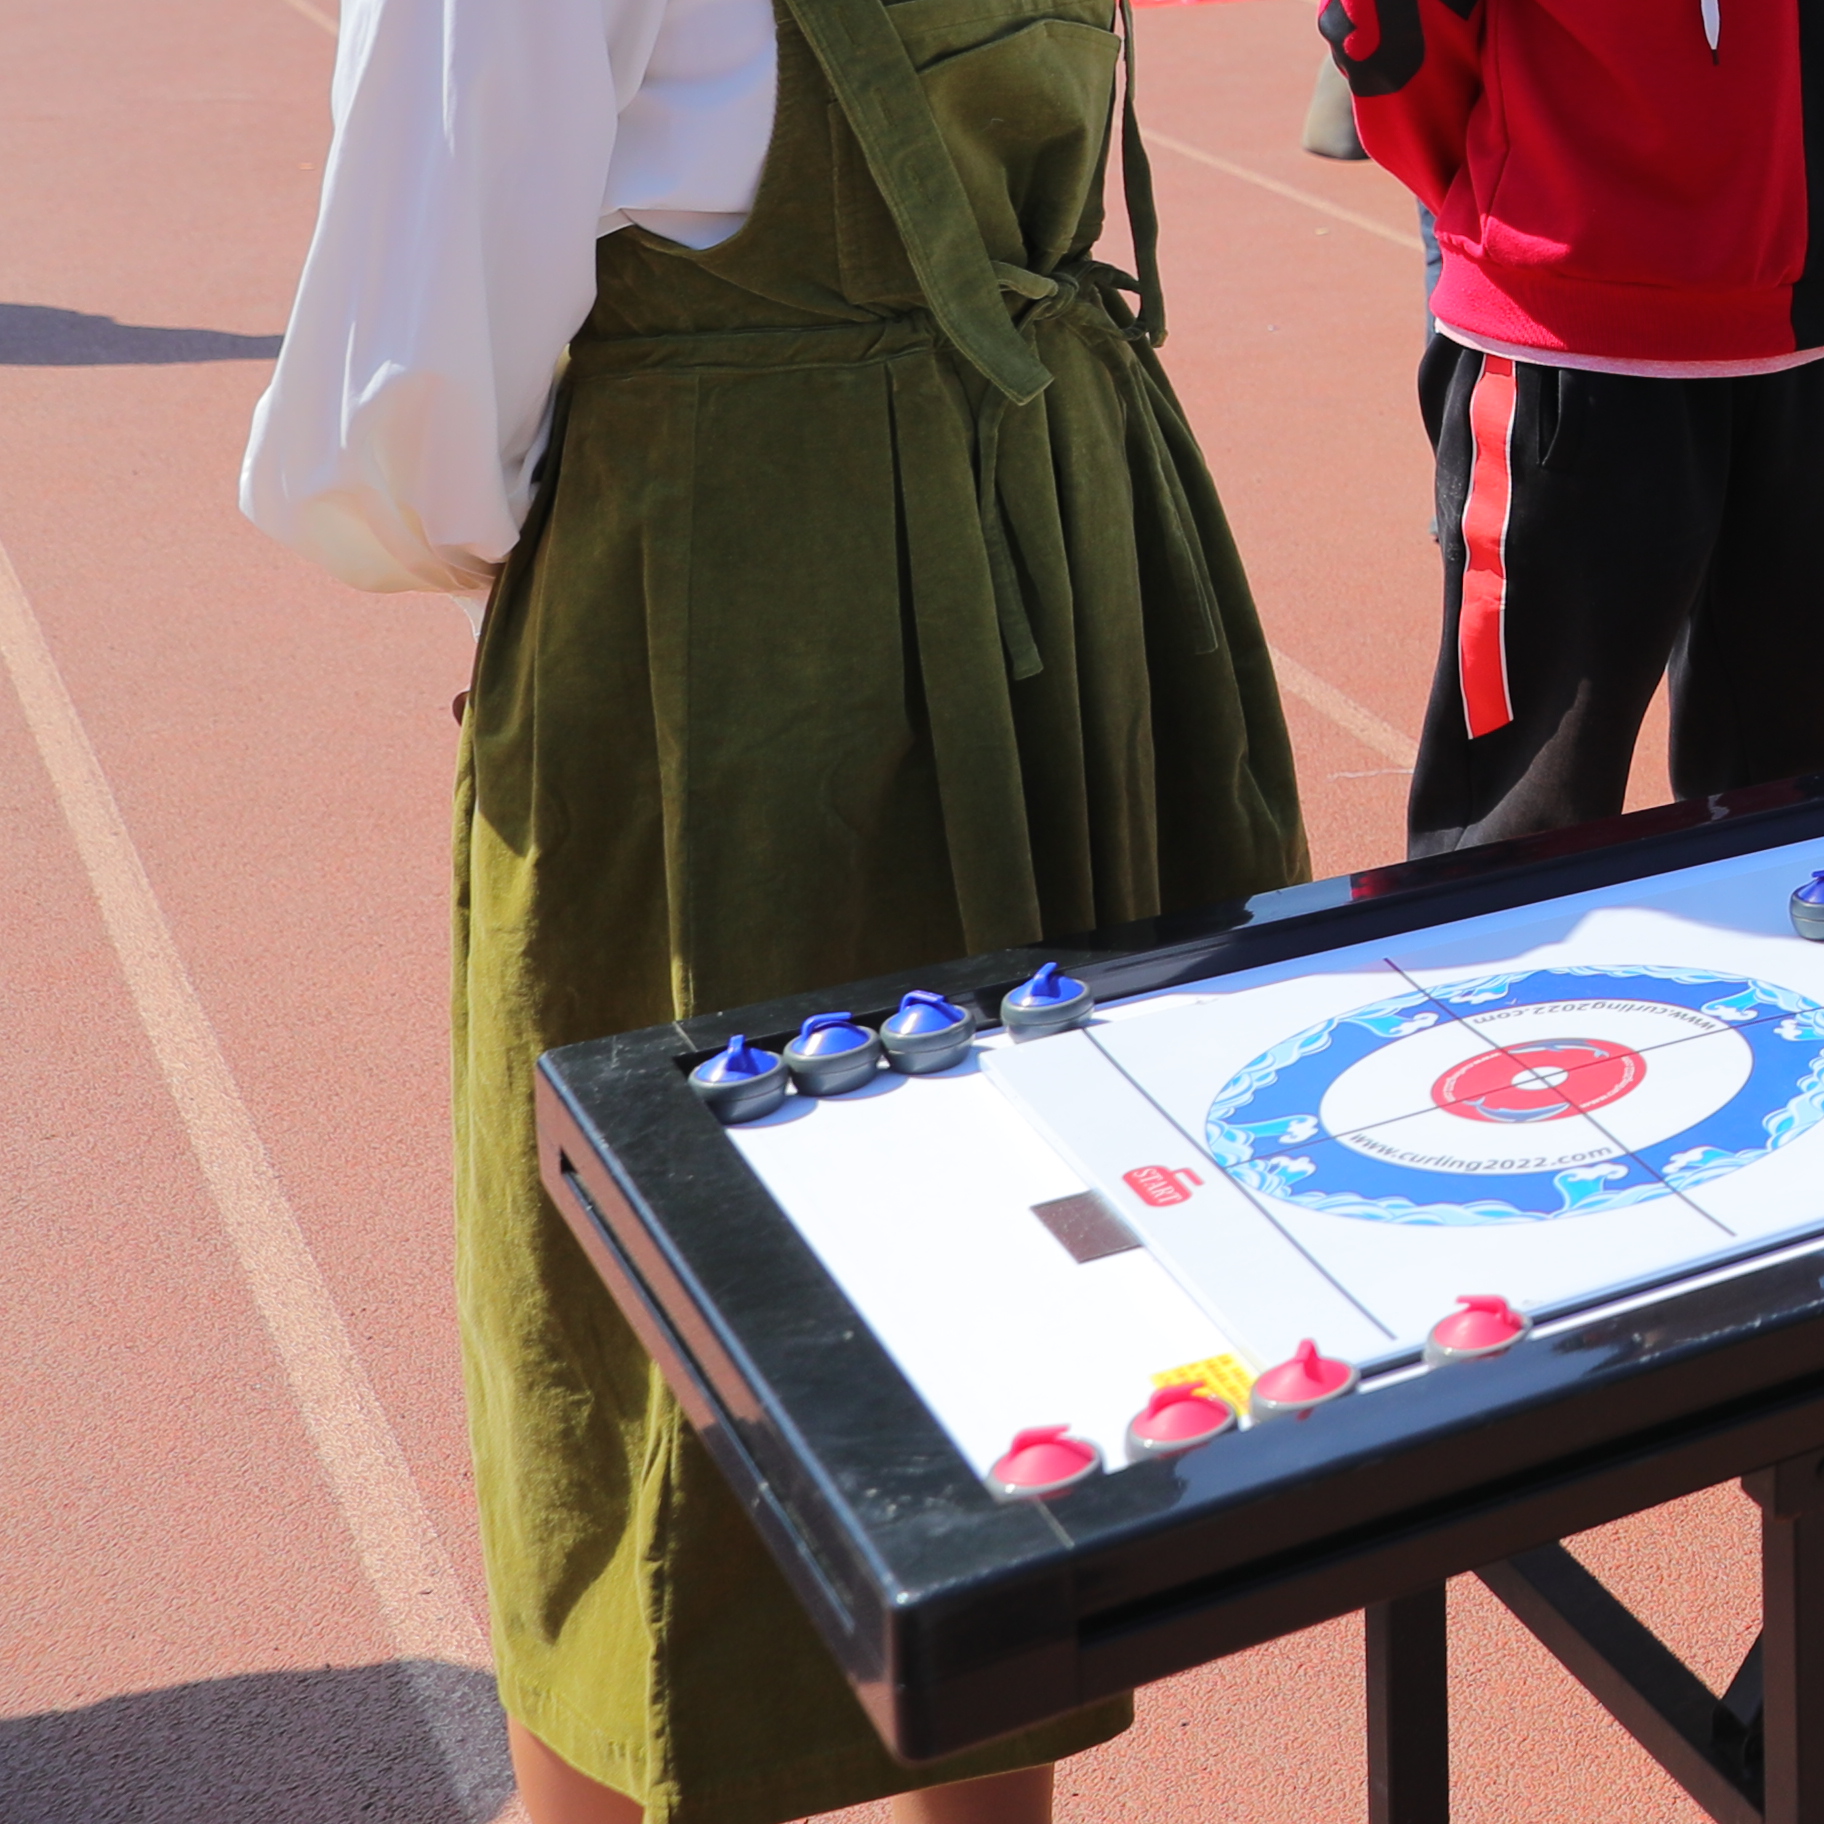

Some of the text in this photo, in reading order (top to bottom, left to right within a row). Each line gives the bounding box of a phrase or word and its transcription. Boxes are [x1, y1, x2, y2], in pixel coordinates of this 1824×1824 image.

[1471, 1000, 1717, 1031] www.curling2022.com
[1349, 1132, 1613, 1172] www.curling2022.com
[1131, 1168, 1183, 1204] START
